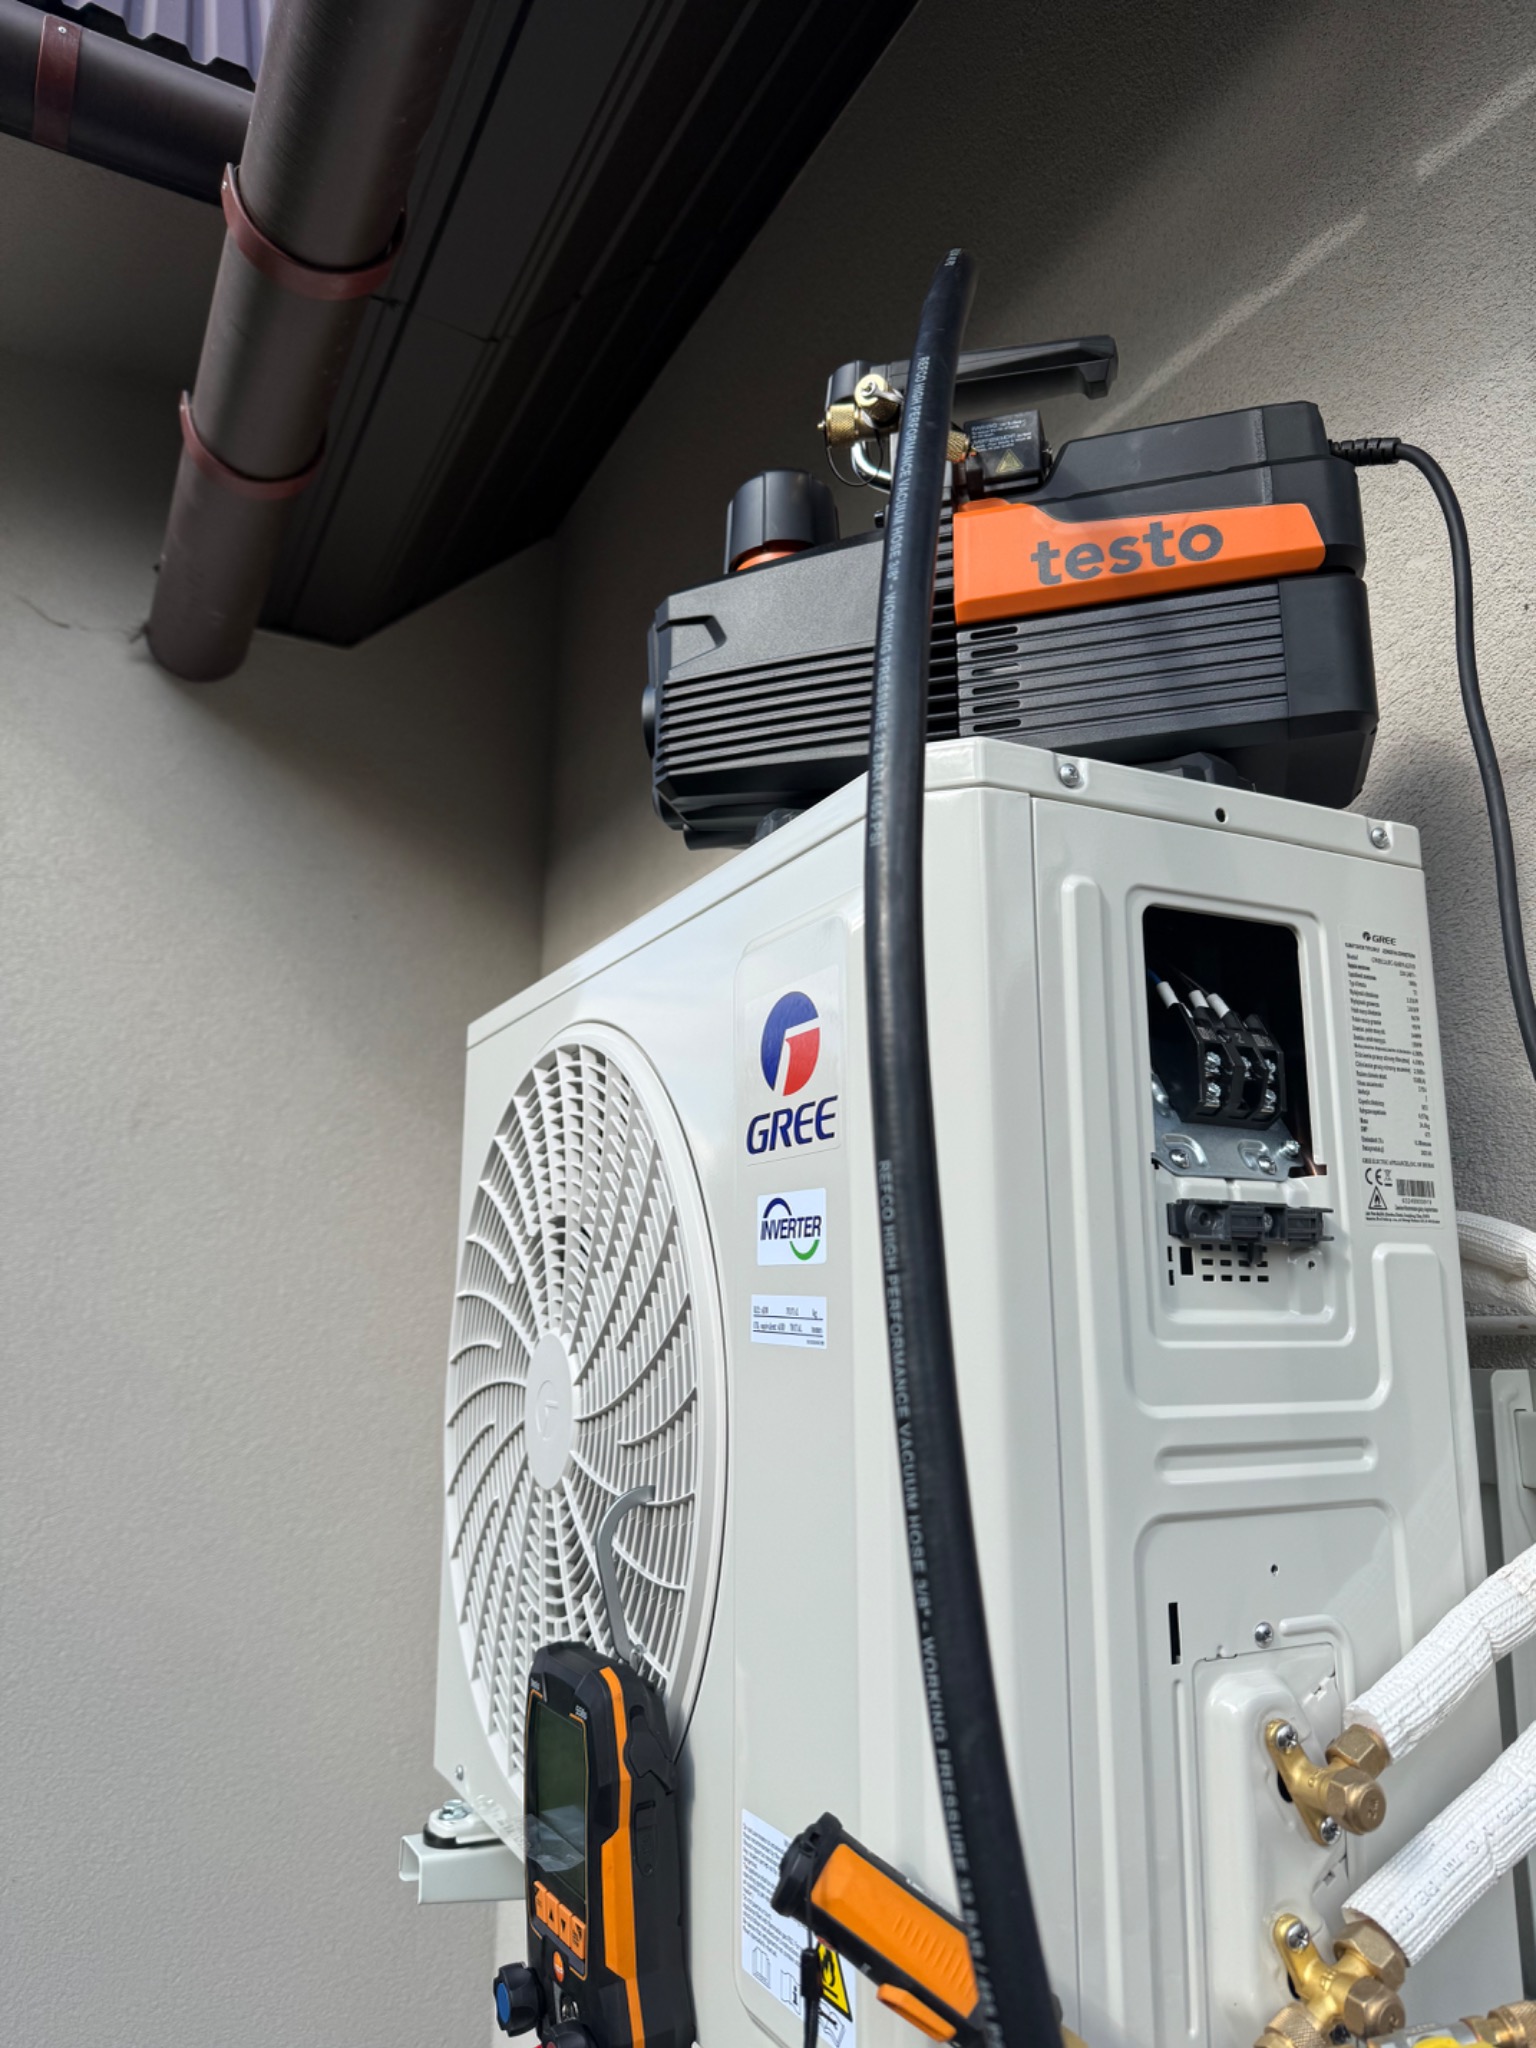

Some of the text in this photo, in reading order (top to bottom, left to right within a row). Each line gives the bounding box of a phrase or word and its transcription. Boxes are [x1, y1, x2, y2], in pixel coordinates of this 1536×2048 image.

[911, 382, 926, 405] HIGH
[914, 356, 931, 382] REFCO
[899, 405, 922, 478] PERFORMANCE
[892, 479, 911, 525] VACUUM
[888, 526, 905, 560] HOSE
[1030, 521, 1224, 586] testo
[880, 592, 897, 655] WORKING
[875, 657, 893, 731] PRESSURE
[1372, 934, 1397, 946] GREE
[746, 1094, 839, 1155] GREE
[878, 1159, 894, 1219] REFCO
[760, 1214, 822, 1241] INVERTER
[882, 1223, 899, 1270] HIGH
[886, 1273, 911, 1418] PERFORMANCE
[898, 1422, 921, 1509] VACUUM
[906, 1514, 928, 1572] HOSE
[920, 1636, 948, 1741] WORKING
[937, 1748, 969, 1871] PRESSURE
[959, 1877, 976, 1905] 32
[964, 1909, 987, 1959] BAR
